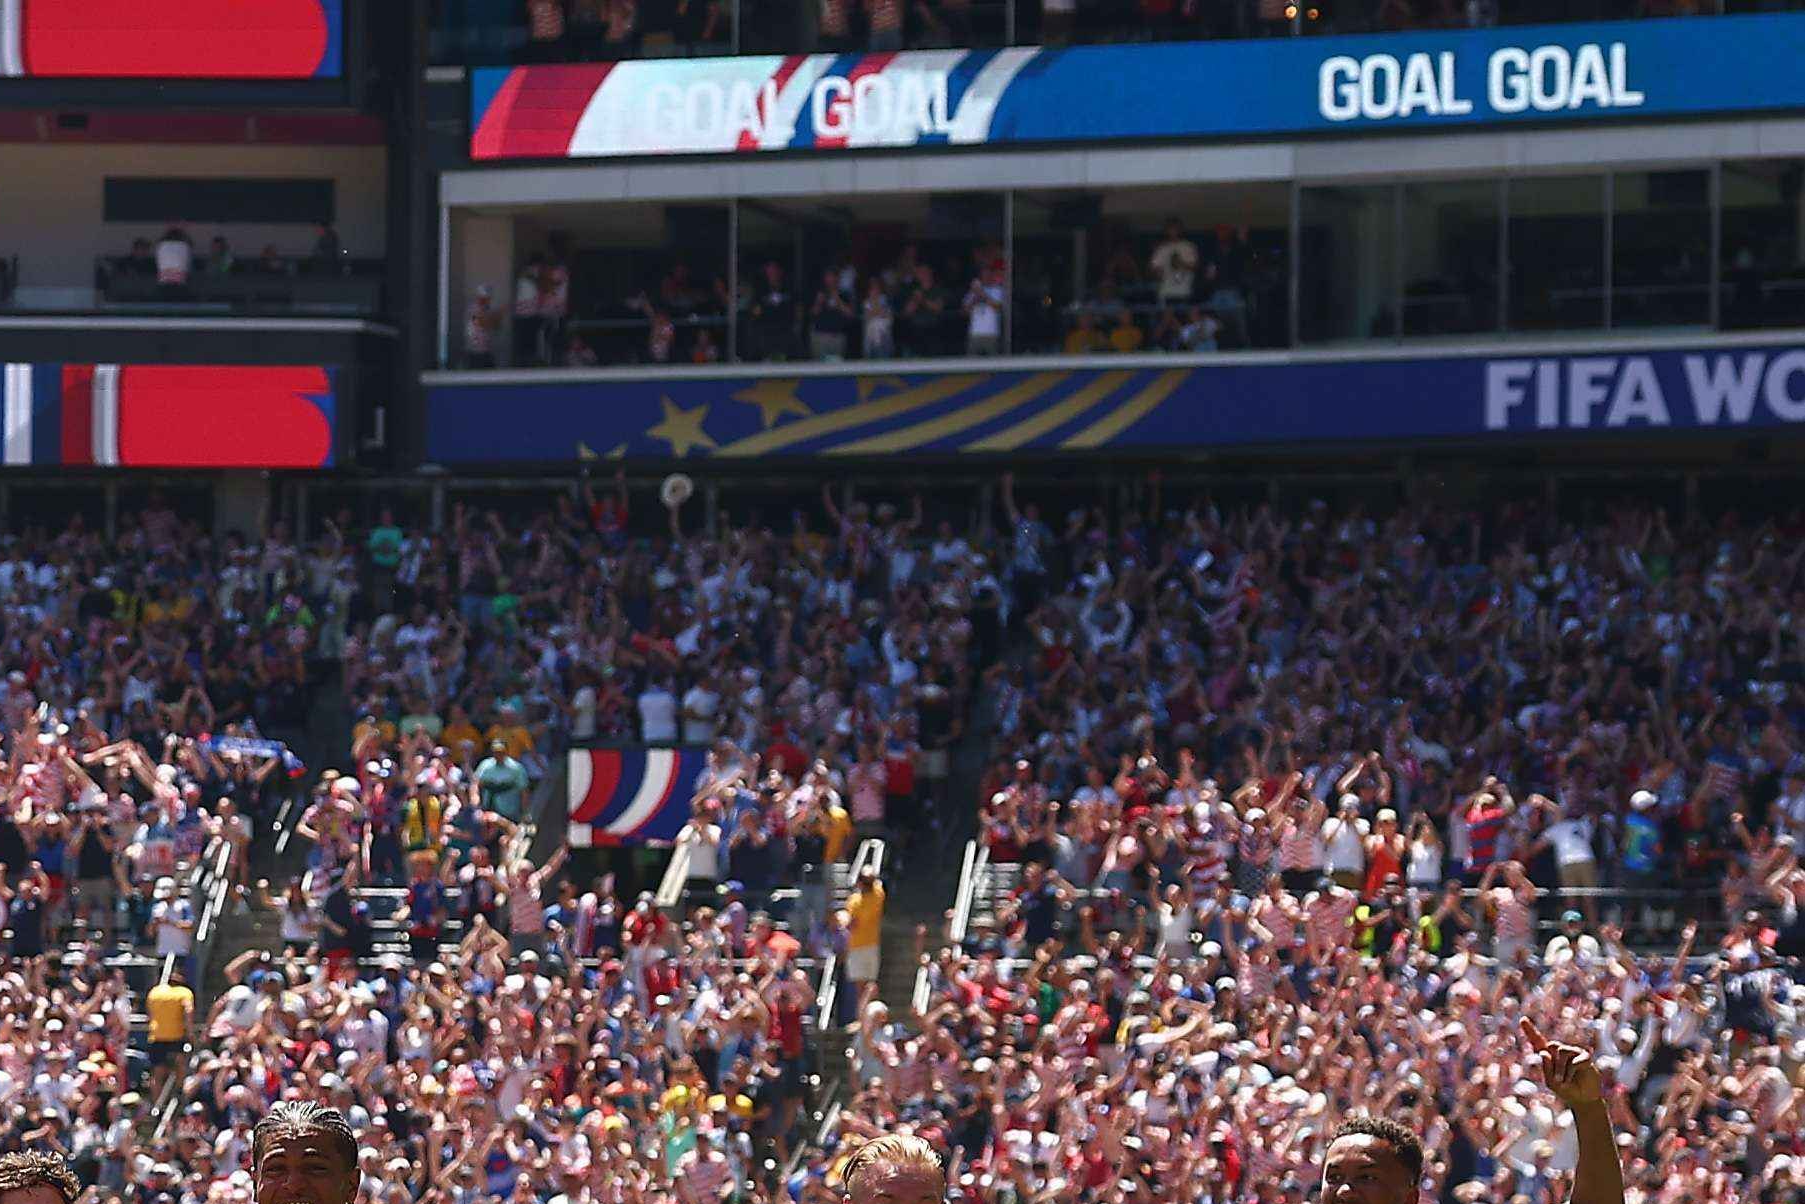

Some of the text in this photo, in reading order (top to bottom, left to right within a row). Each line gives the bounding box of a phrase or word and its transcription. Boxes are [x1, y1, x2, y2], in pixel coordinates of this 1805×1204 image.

[648, 71, 959, 138] GOAL GOAL
[1318, 42, 1645, 121] GOAL GOAL
[1485, 358, 1671, 430] FIFA
